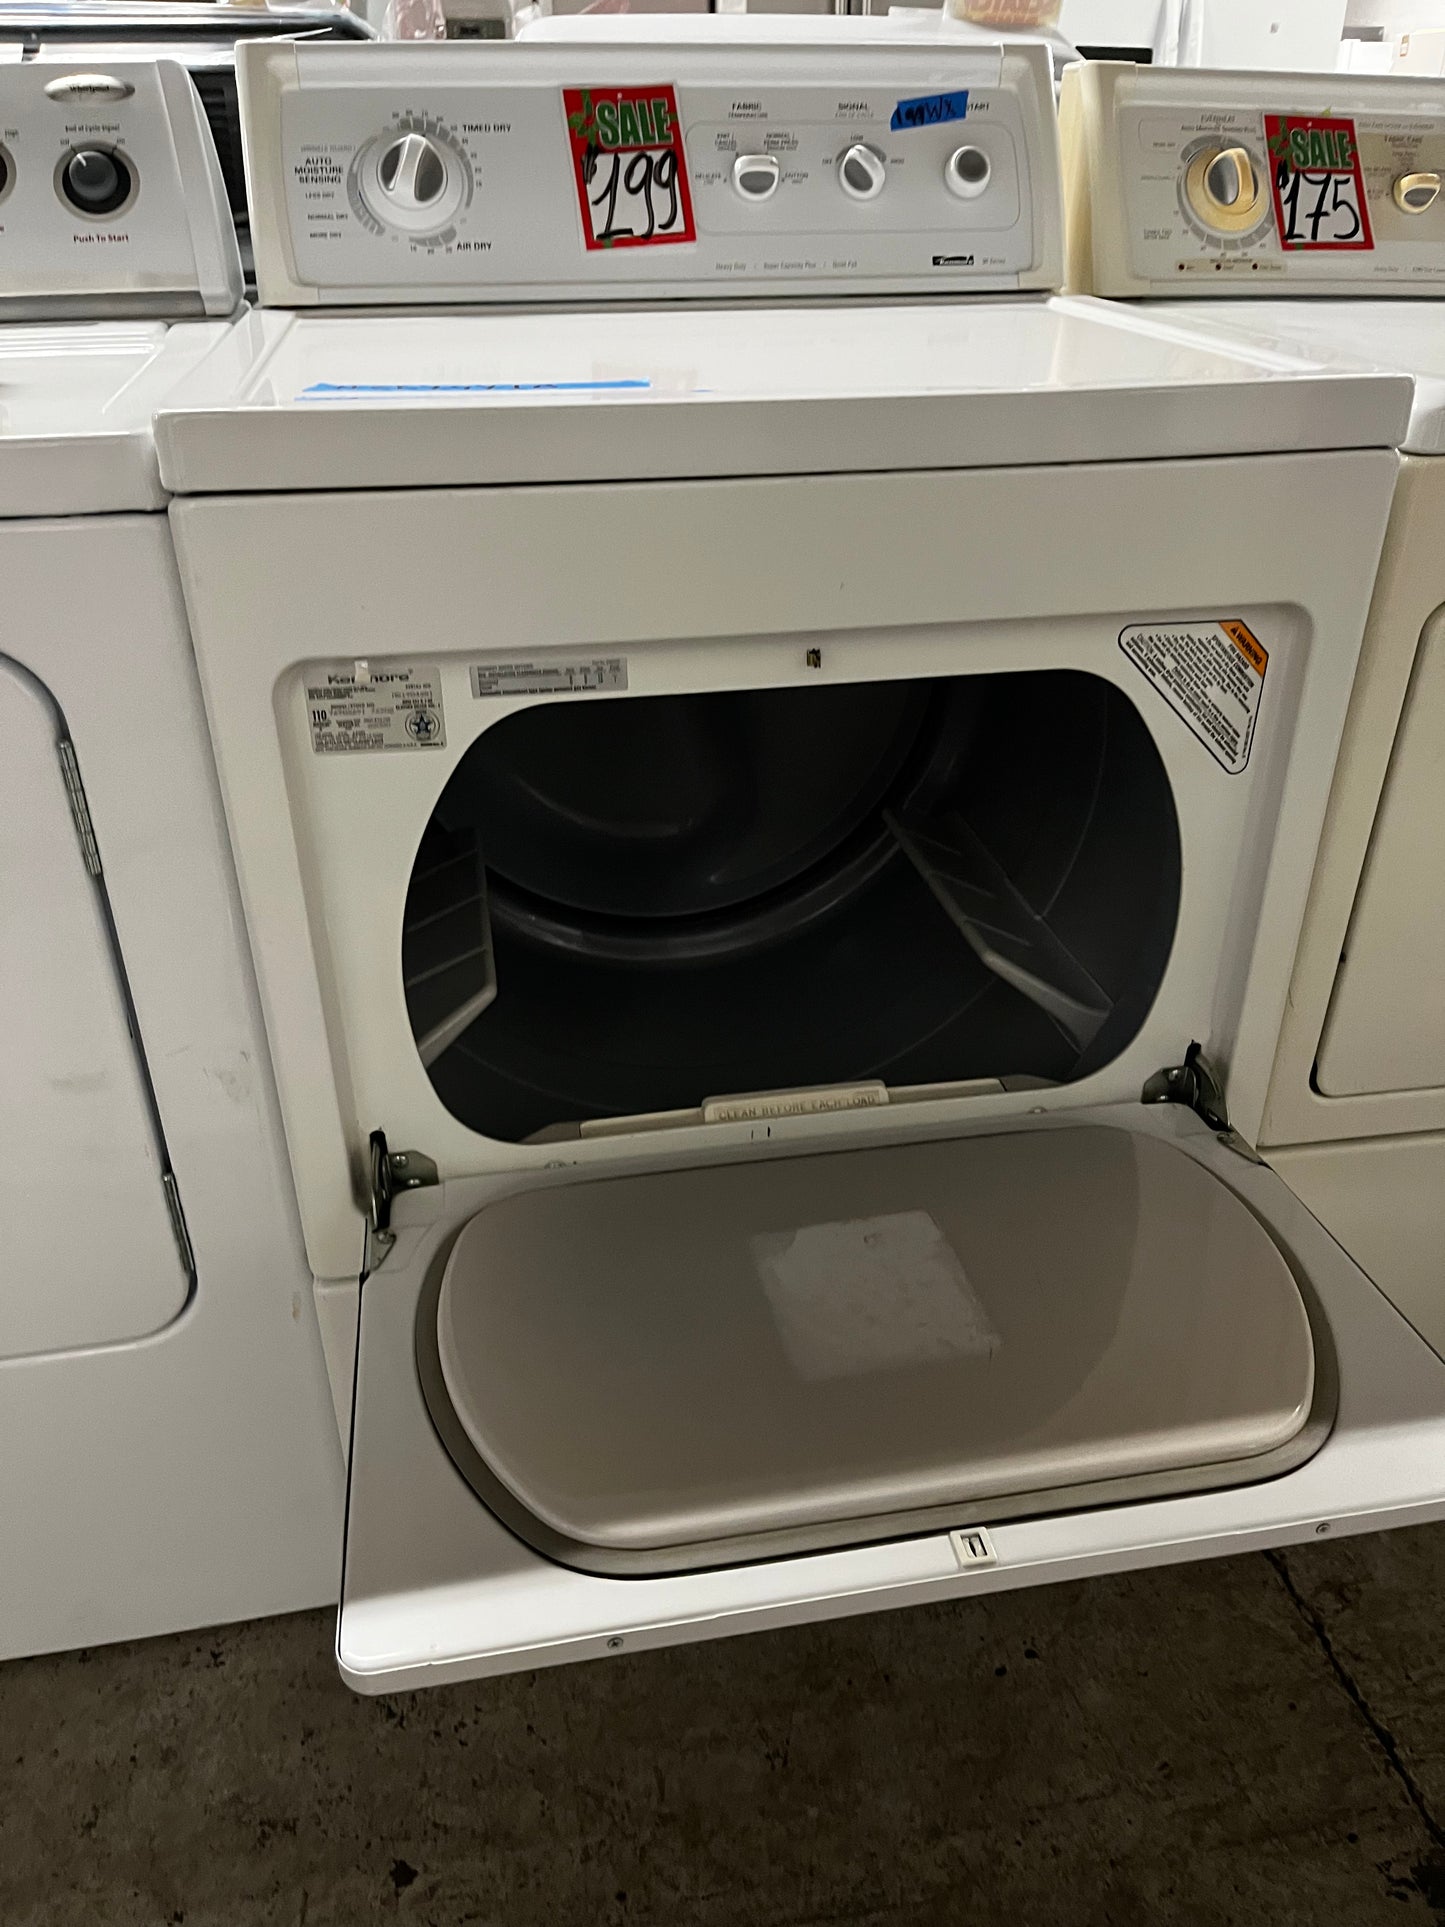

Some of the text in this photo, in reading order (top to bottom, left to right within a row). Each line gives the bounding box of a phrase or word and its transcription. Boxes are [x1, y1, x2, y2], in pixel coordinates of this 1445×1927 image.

[596, 98, 674, 148] SALE
[462, 124, 511, 133] TIMED DRY
[1290, 128, 1354, 169] SALE
[305, 157, 332, 166] AUTO
[294, 166, 344, 175] MOISTURE
[299, 175, 342, 184] SENSING
[73, 233, 129, 243] Push To Start
[456, 242, 492, 251] AIR DRY
[1235, 632, 1263, 666] WARNING
[312, 709, 327, 721] 110
[718, 1095, 876, 1122] CLEAN BEFORE EACH LOAD
